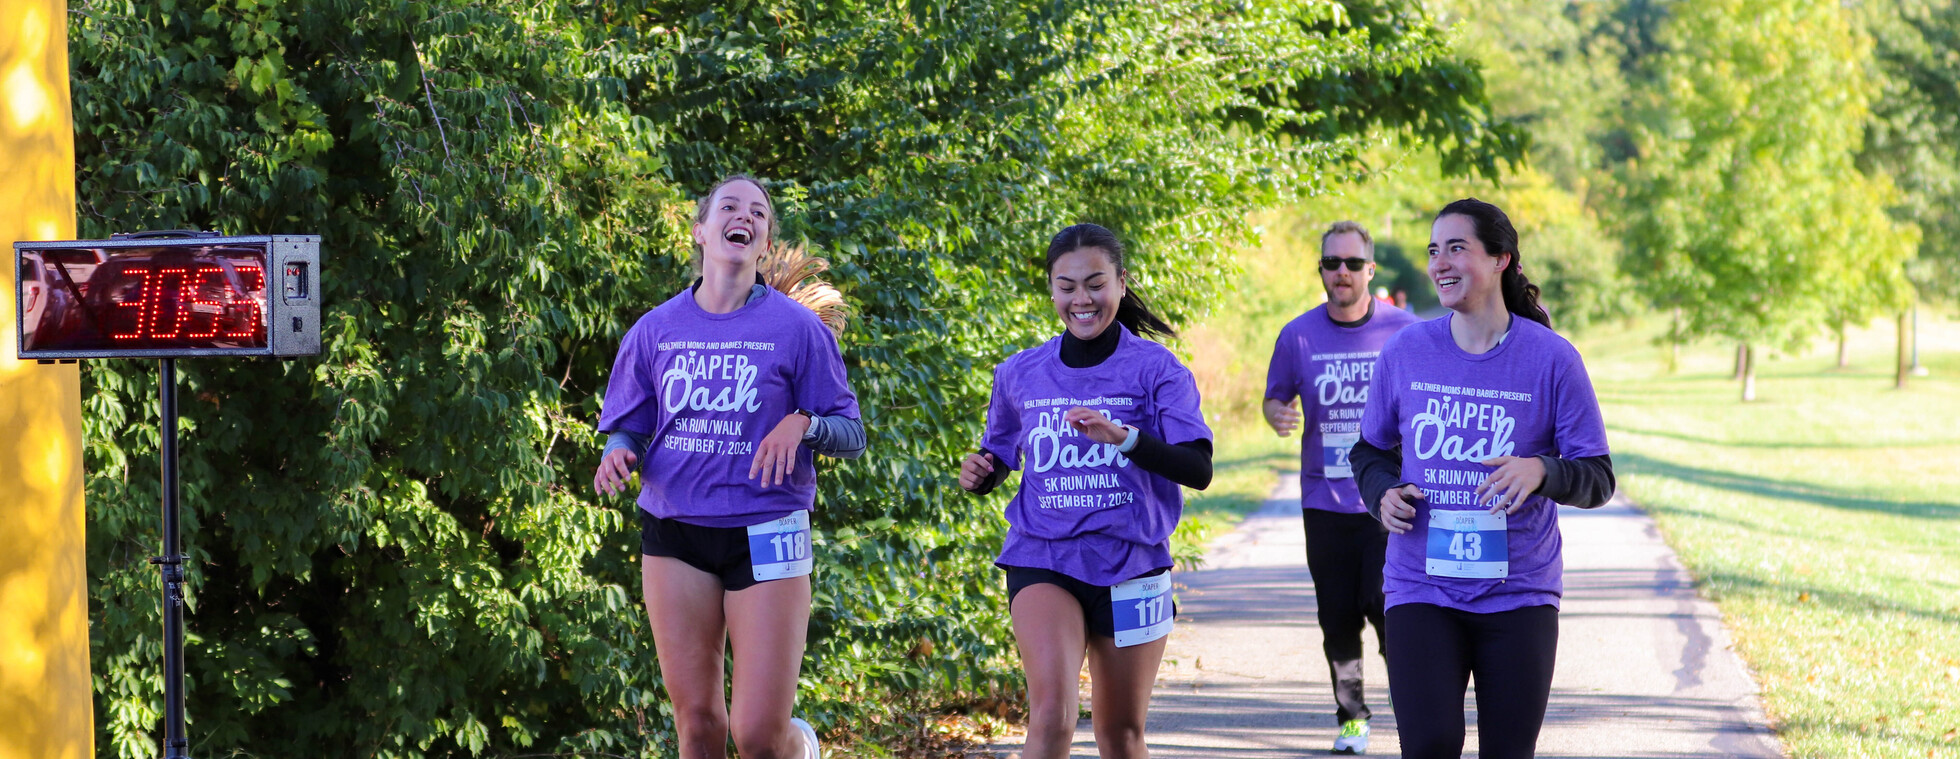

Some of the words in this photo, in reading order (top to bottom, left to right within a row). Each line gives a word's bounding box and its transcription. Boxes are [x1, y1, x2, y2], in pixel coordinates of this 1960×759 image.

[657, 341, 686, 351] HEALTHIER
[687, 341, 706, 350] MOMS
[706, 341, 720, 350] AND
[720, 341, 743, 350] BABIES
[743, 341, 775, 351] PRESENTS
[662, 365, 763, 413] Dash
[1314, 374, 1370, 406] Das
[1410, 381, 1441, 393] HEALTHIER
[1441, 385, 1461, 395] MOMS
[1461, 387, 1475, 396] AND
[1476, 388, 1499, 399] BABIES
[1499, 391, 1532, 402] PRESENTS
[1023, 399, 1051, 410] HEALTHIER
[1051, 397, 1069, 406] MOMS
[1069, 398, 1082, 406] AND
[1082, 396, 1103, 406] BABIES
[1103, 397, 1133, 406] PRESENTS
[1328, 409, 1339, 420] 5K
[675, 418, 689, 432] 5K
[689, 418, 742, 436] RUN/WALK
[1320, 422, 1360, 433] SEPTEMBER
[664, 434, 714, 454] SEPTEMBER
[717, 440, 726, 456] 7,
[727, 442, 752, 455] 2024
[1044, 477, 1059, 493] 5K
[1060, 473, 1120, 491] RUN/WALK
[1424, 468, 1437, 484] 5K
[1038, 494, 1095, 509] SEPTEMBER
[1096, 494, 1106, 508] 7,
[1108, 491, 1134, 507] 2024
[770, 532, 805, 561] 118
[1448, 532, 1482, 561] 43
[1135, 595, 1164, 627] 117
